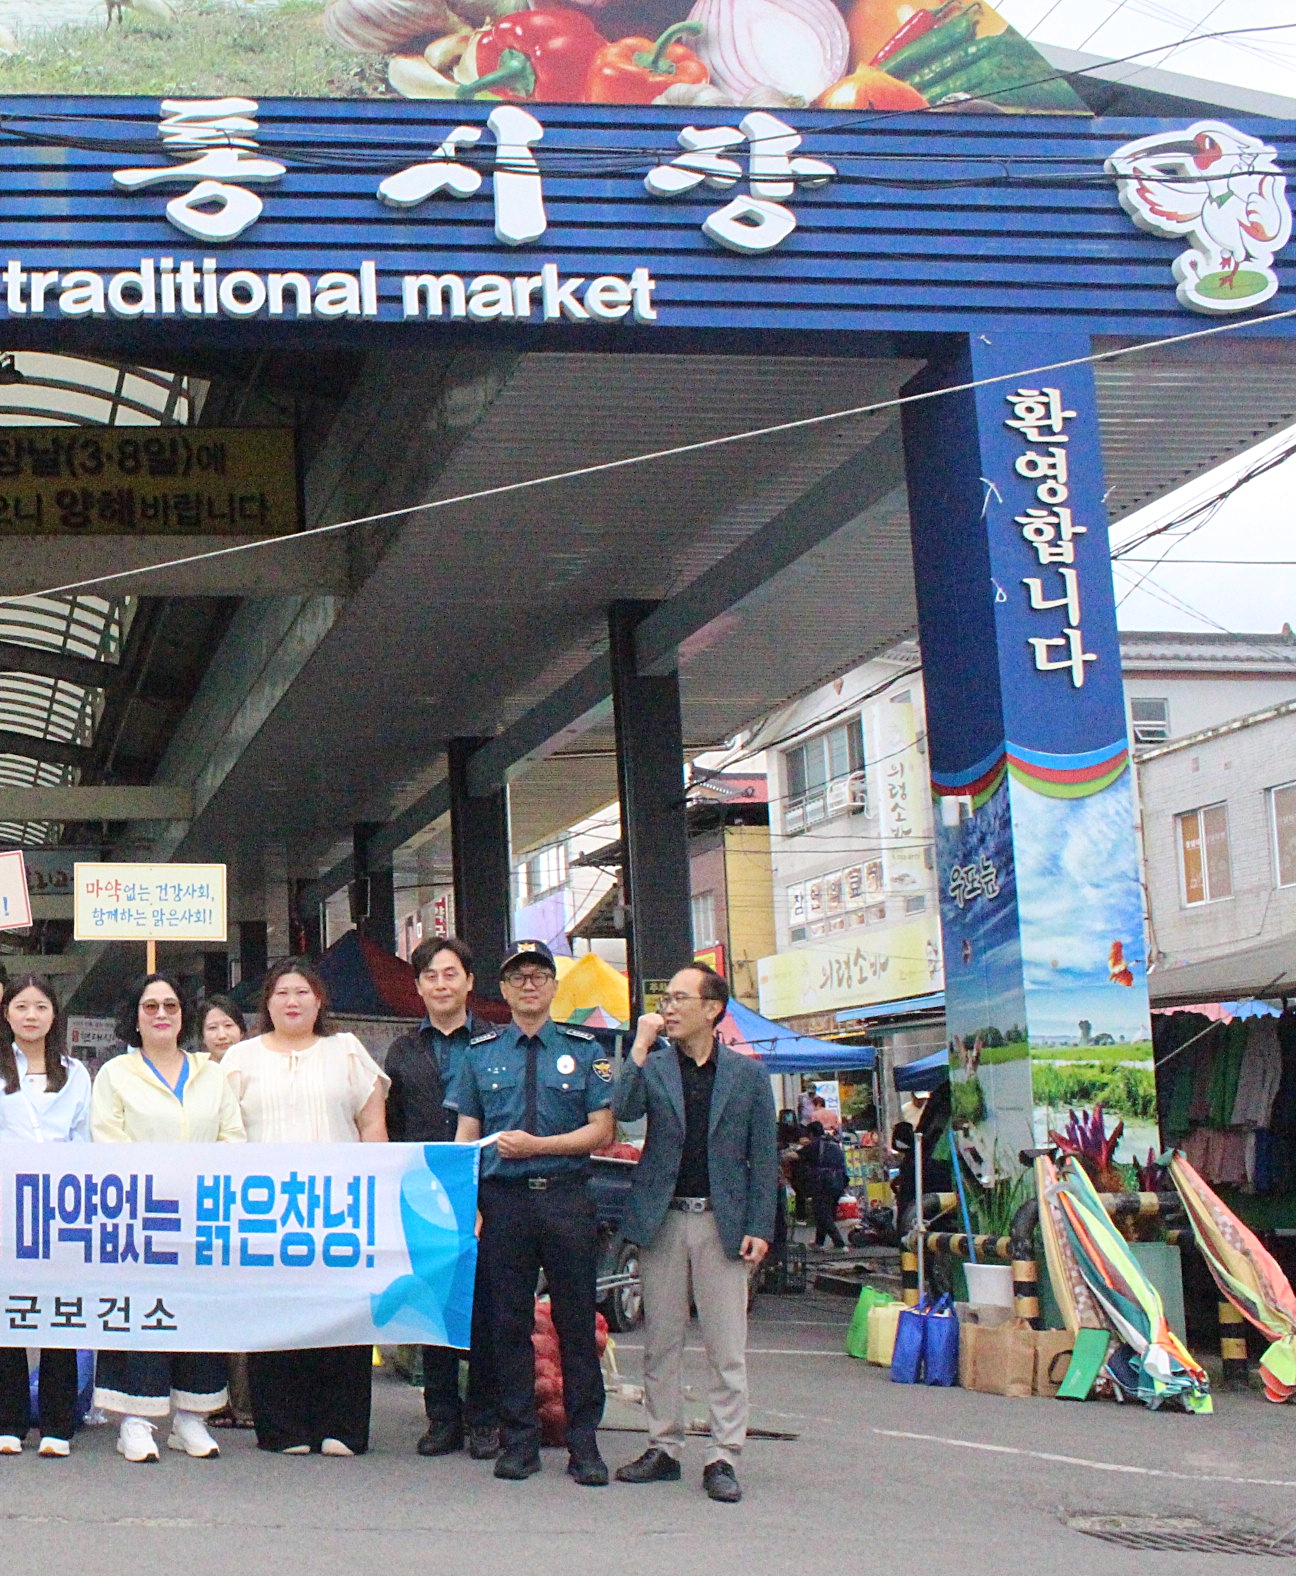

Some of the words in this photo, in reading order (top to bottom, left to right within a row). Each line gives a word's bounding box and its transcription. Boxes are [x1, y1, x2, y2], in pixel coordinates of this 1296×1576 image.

[3, 257, 378, 318] traditional
[403, 263, 658, 323] market
[1005, 387, 1098, 689] 환영합니다
[949, 855, 1000, 908] 우포늪
[15, 1173, 182, 1266] 마약없는
[195, 1171, 376, 1268] 밝은창녕!
